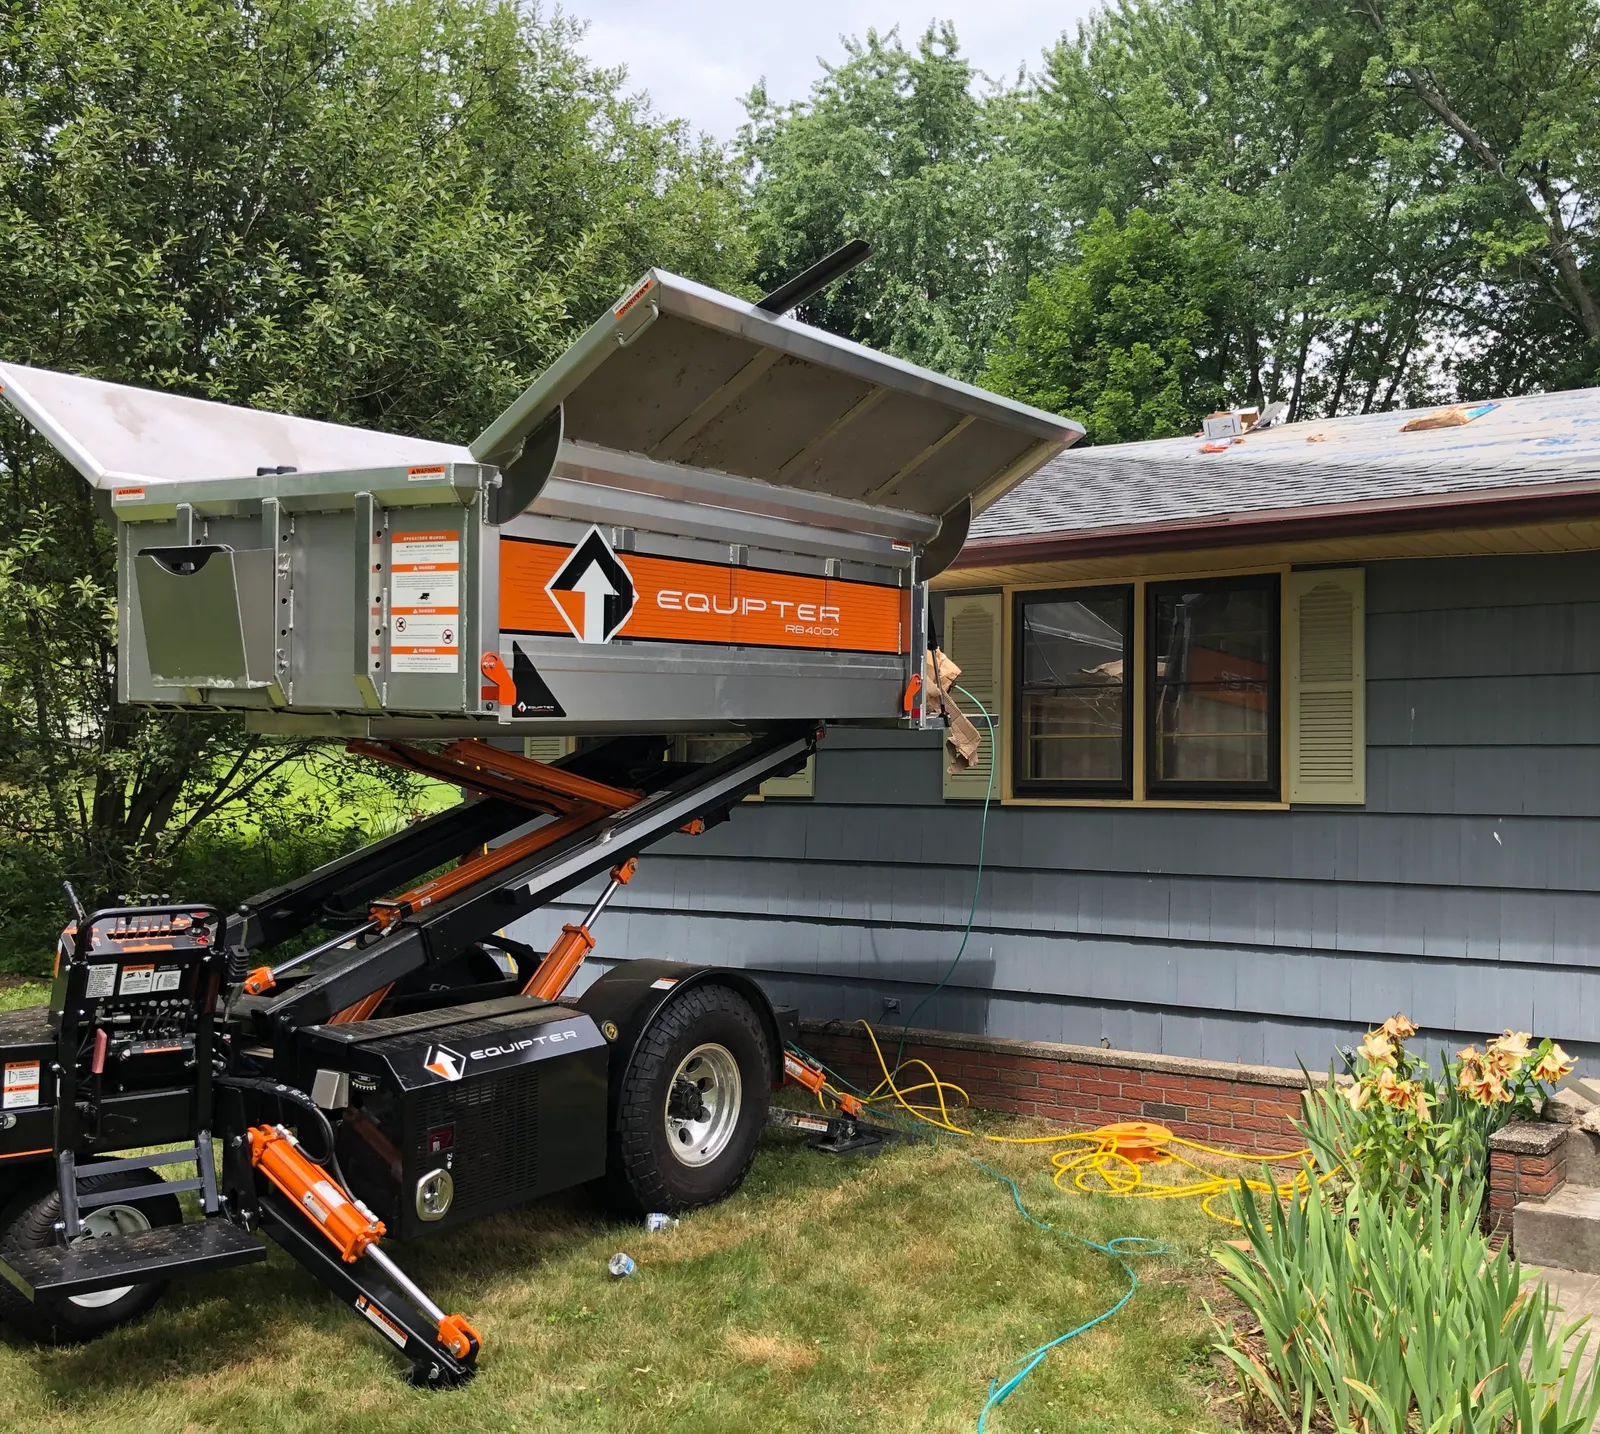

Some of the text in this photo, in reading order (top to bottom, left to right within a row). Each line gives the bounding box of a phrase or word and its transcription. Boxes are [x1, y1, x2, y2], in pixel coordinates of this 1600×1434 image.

[656, 590, 840, 623] EQUIPTER
[470, 1030, 578, 1060] EQUIPTER
[382, 1316, 408, 1341] WARNING
